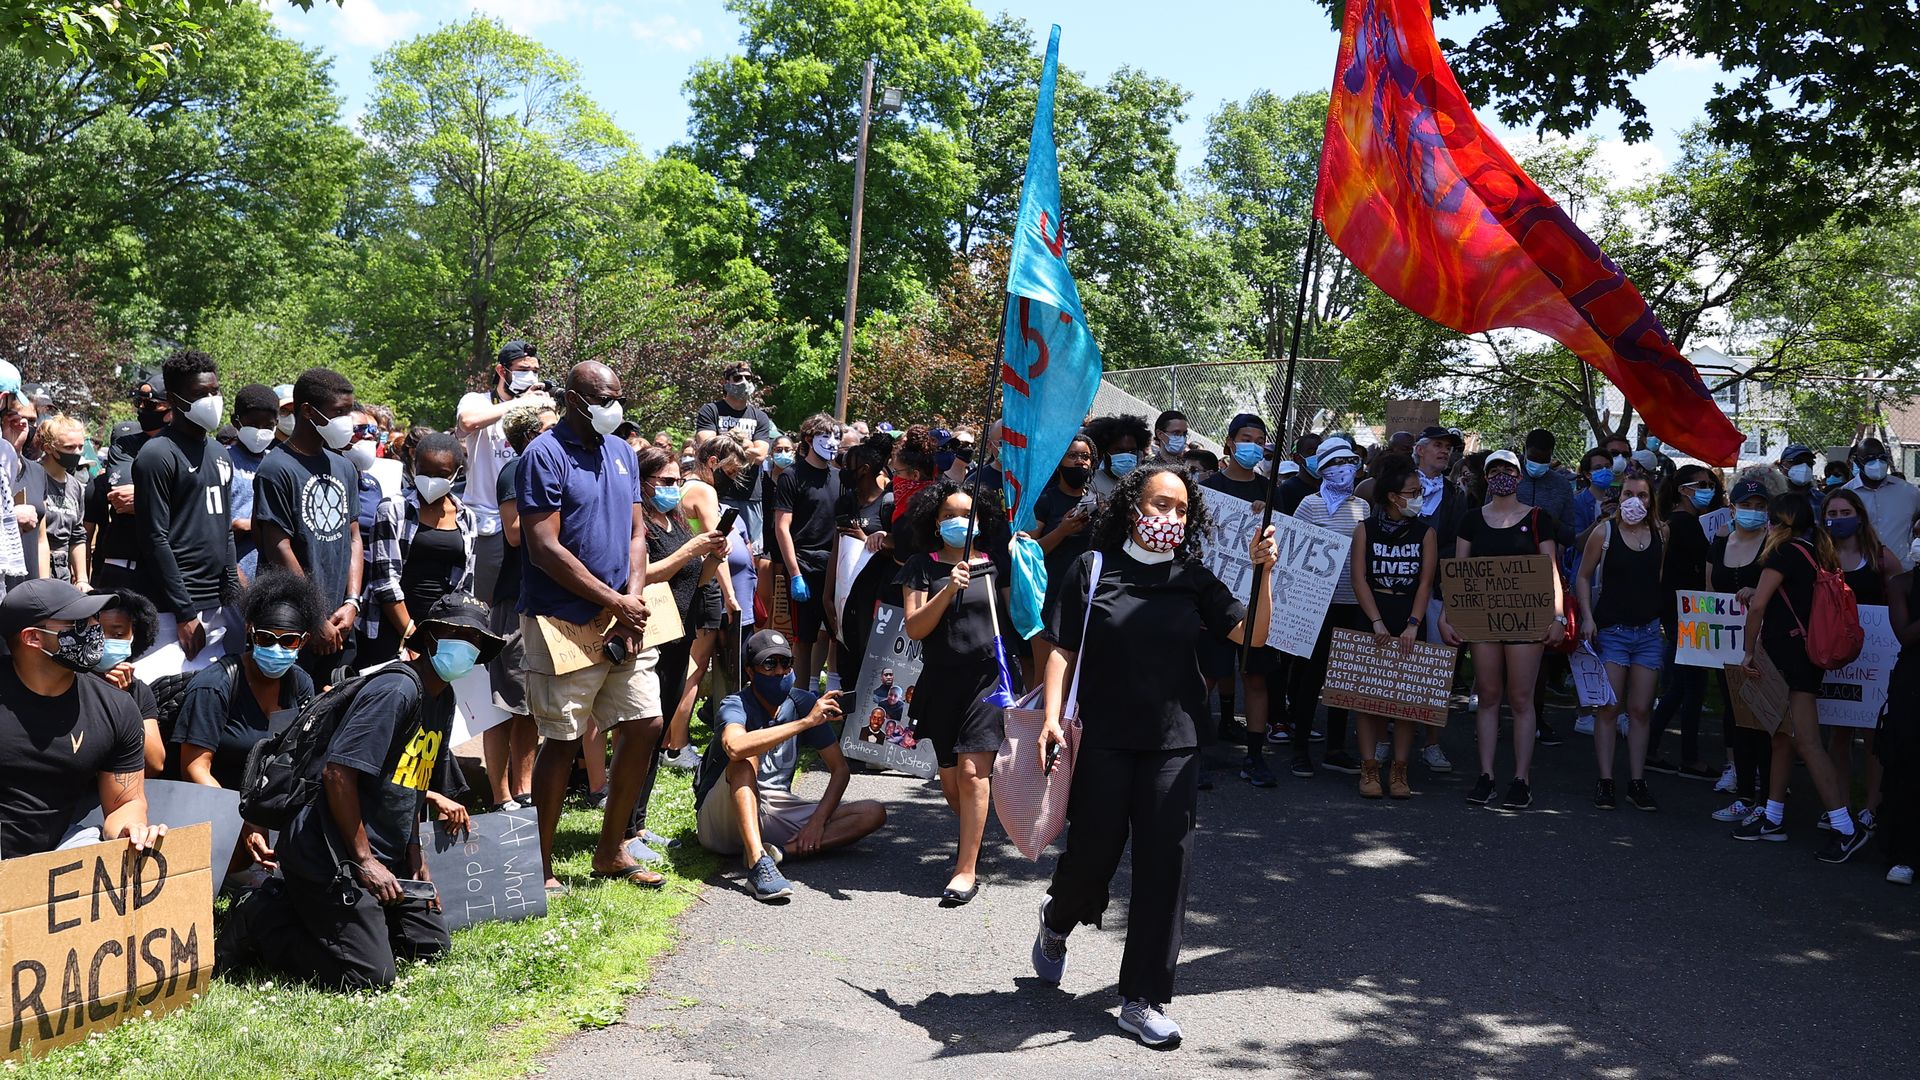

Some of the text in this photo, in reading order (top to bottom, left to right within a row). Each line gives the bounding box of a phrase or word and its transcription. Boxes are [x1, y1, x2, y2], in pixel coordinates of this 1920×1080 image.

[314, 531, 343, 542] FUTURES
[1290, 520, 1315, 533] MICHAEL
[1277, 525, 1339, 578] IVES
[1372, 542, 1421, 558] BLACK
[1203, 549, 1294, 605] ATTR
[1372, 560, 1420, 575] LIVES
[1445, 559, 1537, 578] CHANGE WILL
[1464, 577, 1520, 592] BE MADE
[1450, 592, 1552, 609] START BELIEVING
[1681, 595, 1726, 616] BLACK
[1487, 611, 1536, 632] NOW!
[893, 635, 923, 663] ON
[1333, 630, 1351, 641] ERIC
[1353, 633, 1377, 645] GAR
[1424, 645, 1452, 658] BLAND
[1677, 620, 1746, 652] MATT
[1329, 651, 1454, 679] ALTON STERLING FREDDIE GRAY
[1332, 640, 1355, 651] TAMIR
[1357, 644, 1375, 655] RICE
[1419, 655, 1448, 668] MARTIN
[1326, 669, 1452, 699] CASTLE AHMAUD ARBERY TONY
[1332, 661, 1445, 688] BREONNA TAYLOR PHILANDO
[1825, 666, 1879, 681] MAGINE
[1358, 685, 1394, 699] GEORGE
[1396, 692, 1423, 704] FLOYD
[1428, 698, 1447, 708] MORE
[842, 736, 880, 756] Brothers
[896, 750, 932, 772] Sisters
[498, 813, 537, 910] At what
[466, 861, 495, 892] do
[48, 847, 168, 935] END
[465, 896, 496, 920] I
[9, 922, 199, 1052] RACISM
